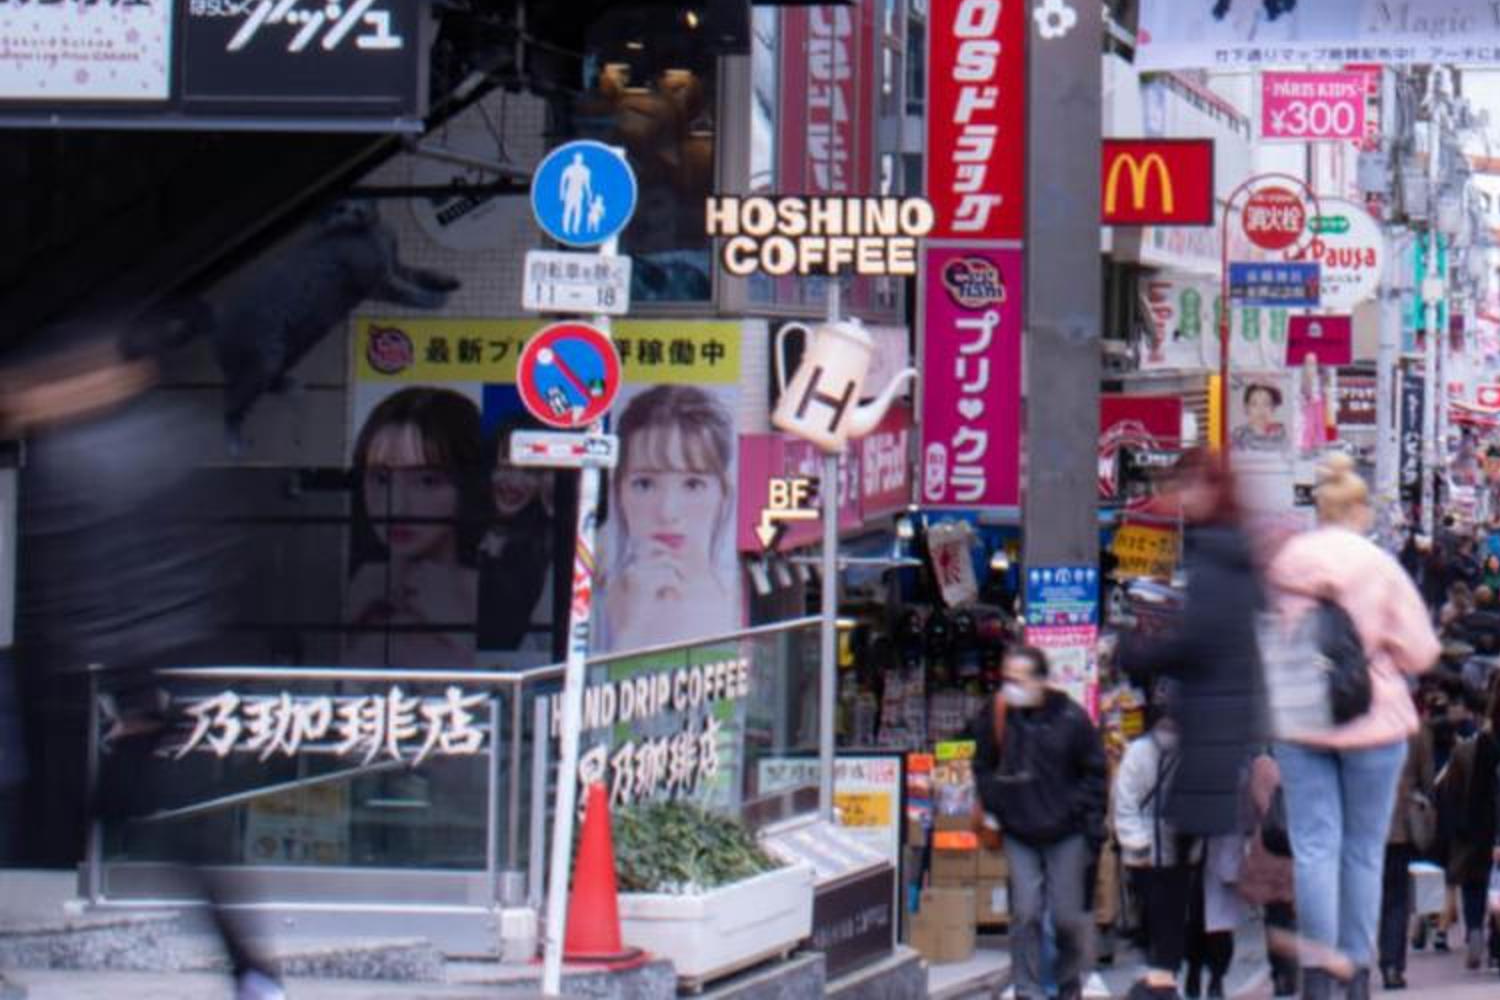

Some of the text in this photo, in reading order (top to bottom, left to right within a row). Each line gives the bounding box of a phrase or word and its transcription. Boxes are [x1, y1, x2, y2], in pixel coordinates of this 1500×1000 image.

[1270, 100, 1356, 136] ¥300
[704, 196, 935, 236] HOSHINO
[724, 236, 918, 275] COFFEE
[794, 365, 857, 434] H
[768, 478, 809, 509] BF
[552, 658, 748, 738] HND DRIP COFFEE
[172, 686, 490, 767] 乃珈琲店
